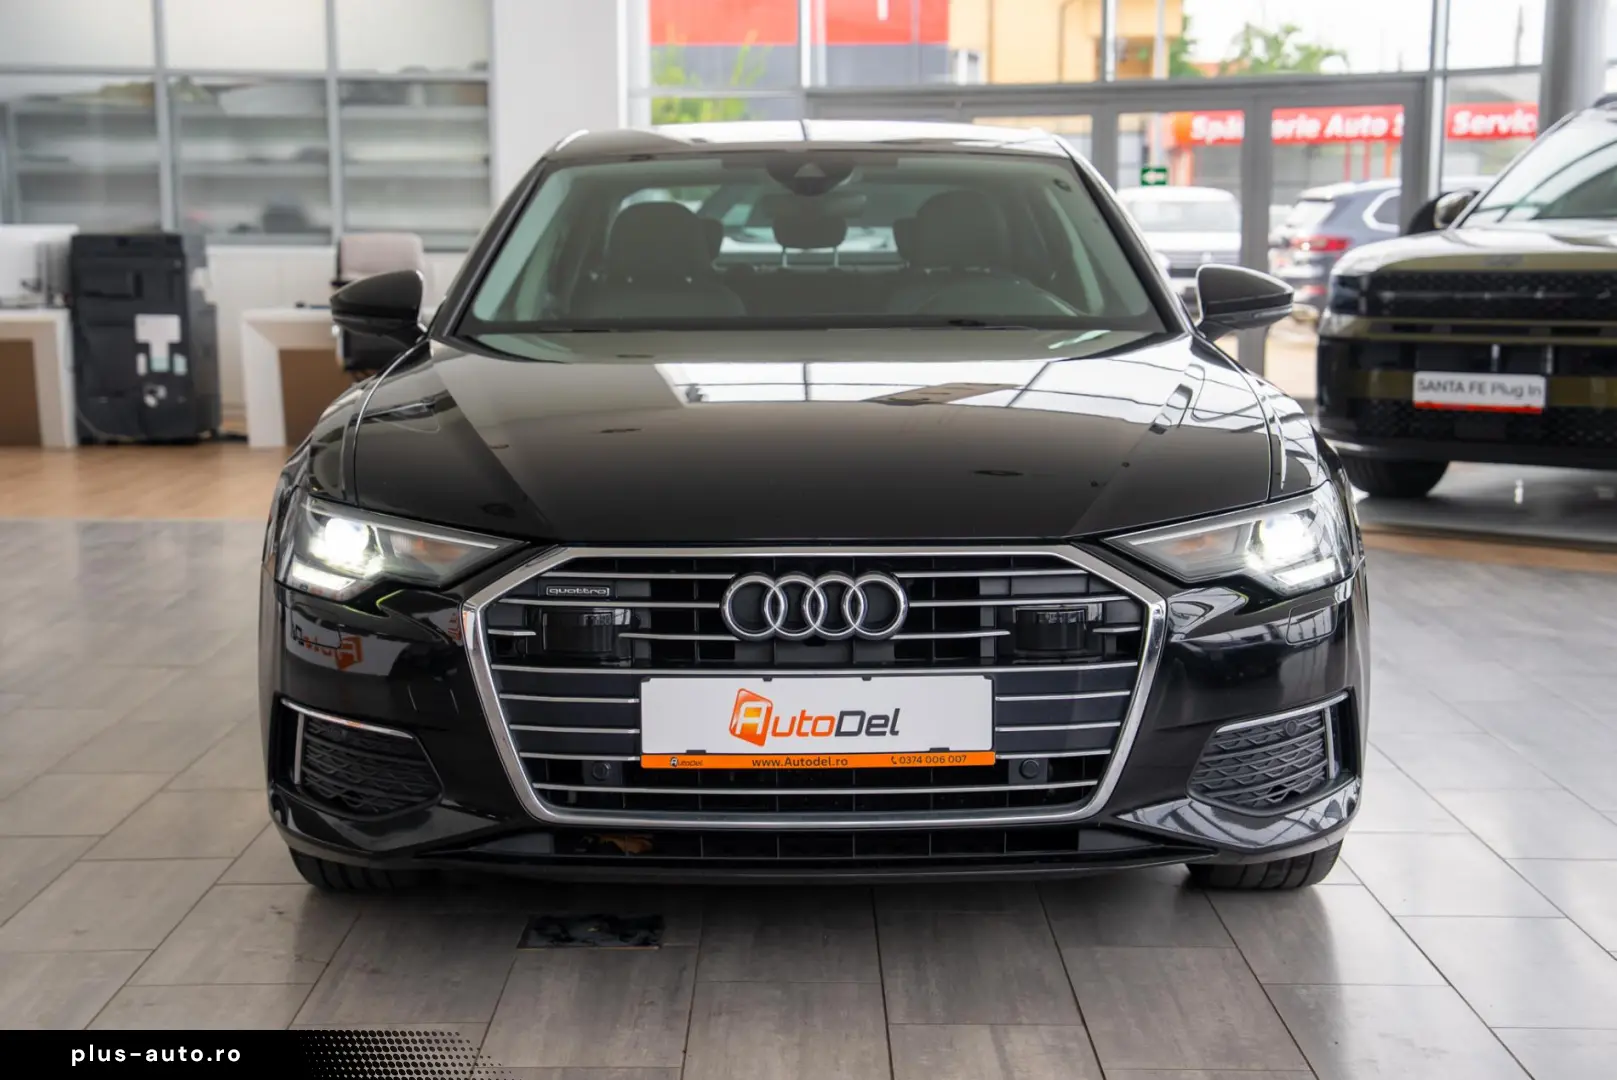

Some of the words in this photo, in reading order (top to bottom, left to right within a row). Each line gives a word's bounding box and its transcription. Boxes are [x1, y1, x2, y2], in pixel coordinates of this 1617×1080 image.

[1323, 112, 1389, 138] Auto
[1452, 109, 1538, 135] Servic
[1418, 379, 1465, 394] SANTA
[1469, 381, 1488, 395] FE
[1491, 381, 1524, 399] Plug
[1528, 384, 1542, 397] In
[549, 587, 607, 596] quattro
[732, 699, 900, 739] AutoDel
[752, 755, 848, 767] www.Autodel.ro
[900, 755, 922, 765] 0374
[925, 755, 945, 764] 006
[948, 754, 967, 764] 007
